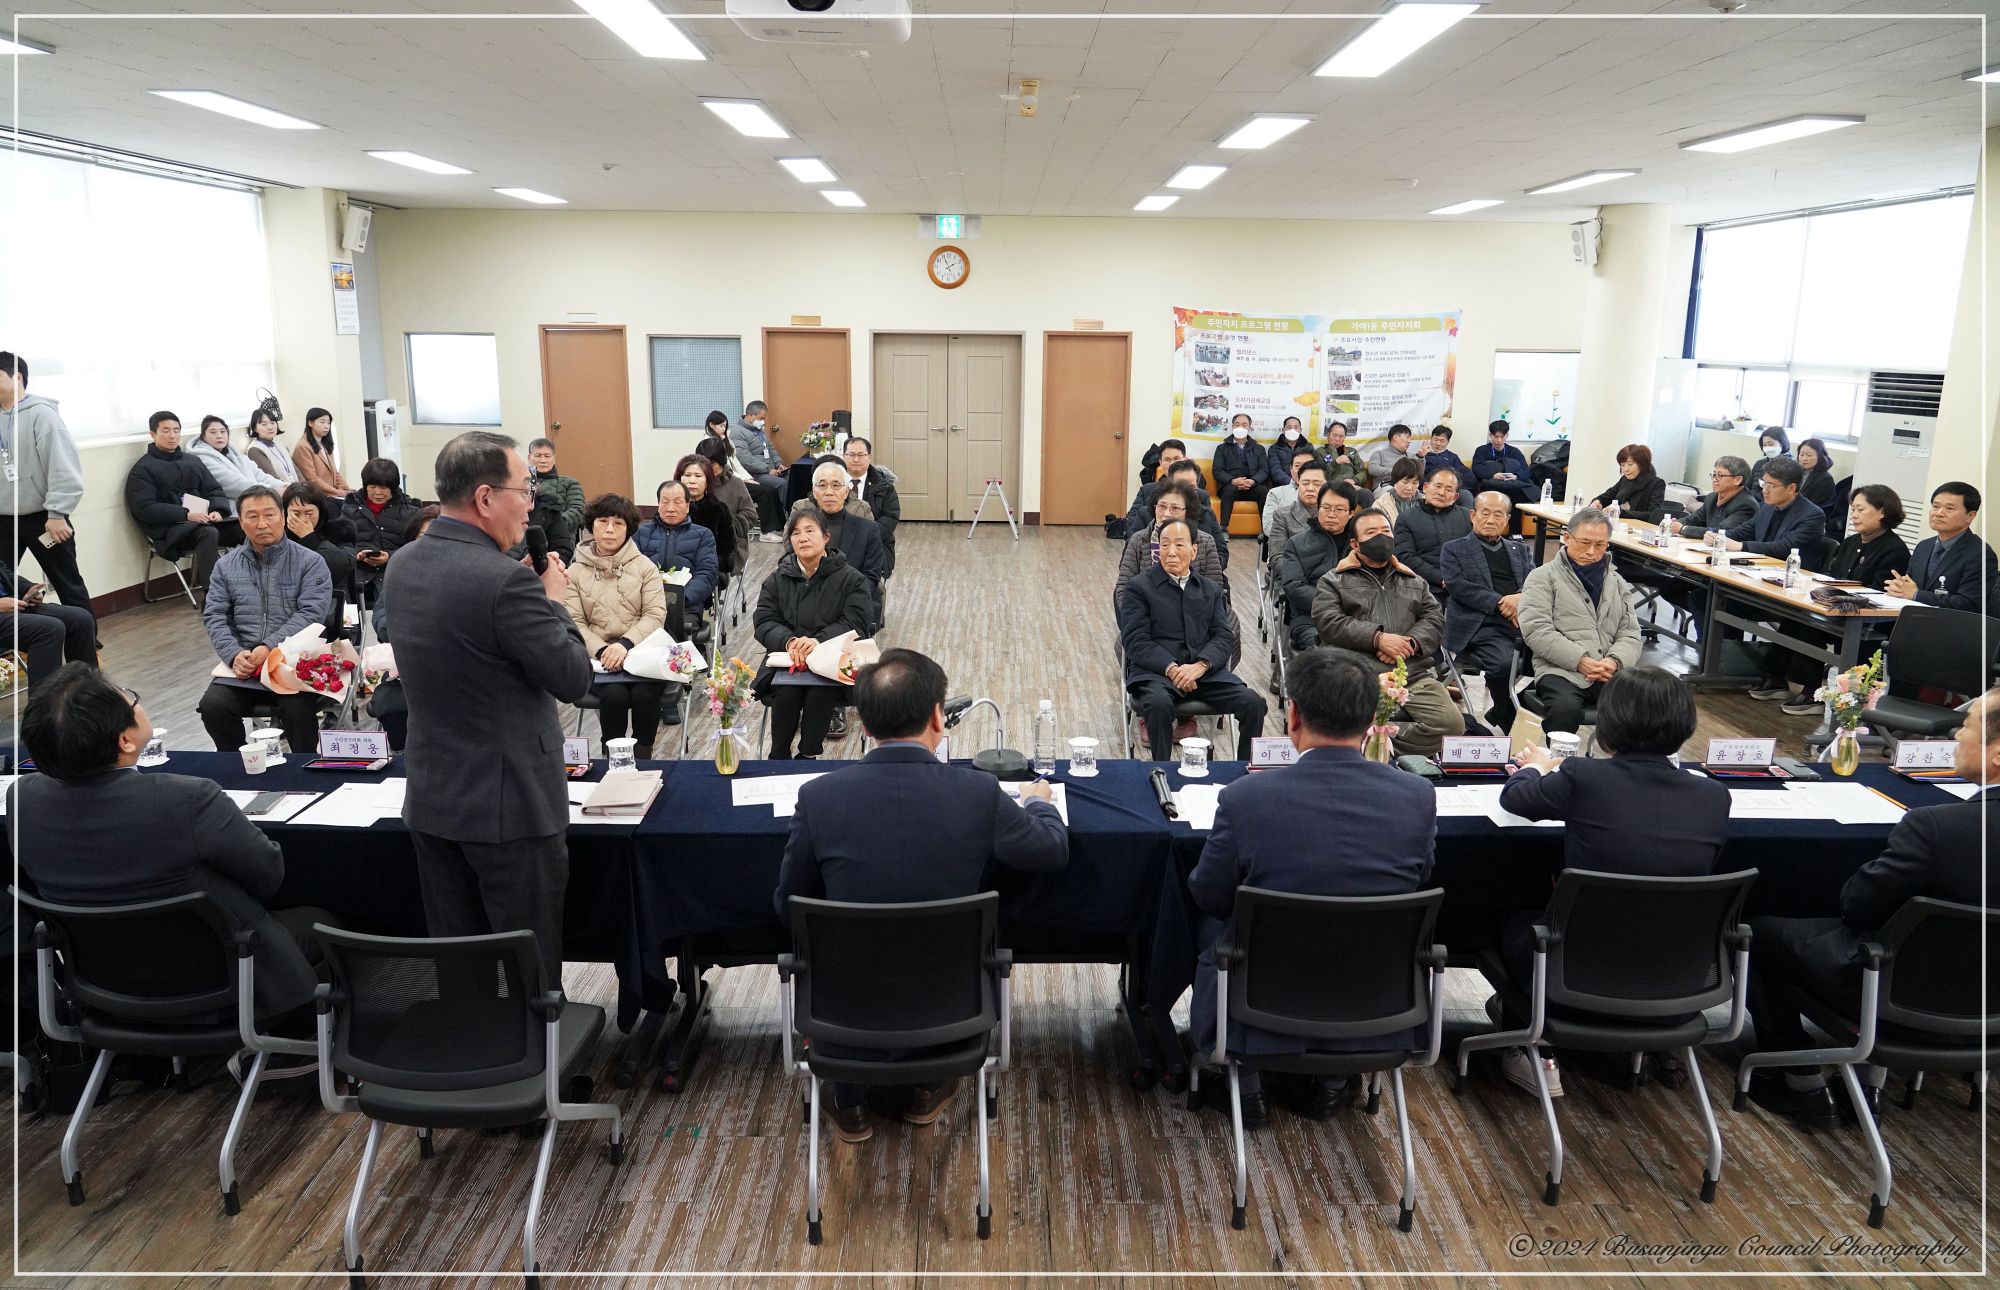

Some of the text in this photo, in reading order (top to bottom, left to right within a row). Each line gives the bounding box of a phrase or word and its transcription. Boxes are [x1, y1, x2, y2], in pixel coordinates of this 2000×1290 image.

[1207, 318, 1289, 331] 주민자치 프로그램 현황
[1351, 320, 1421, 331] 가야1동 주민자치회
